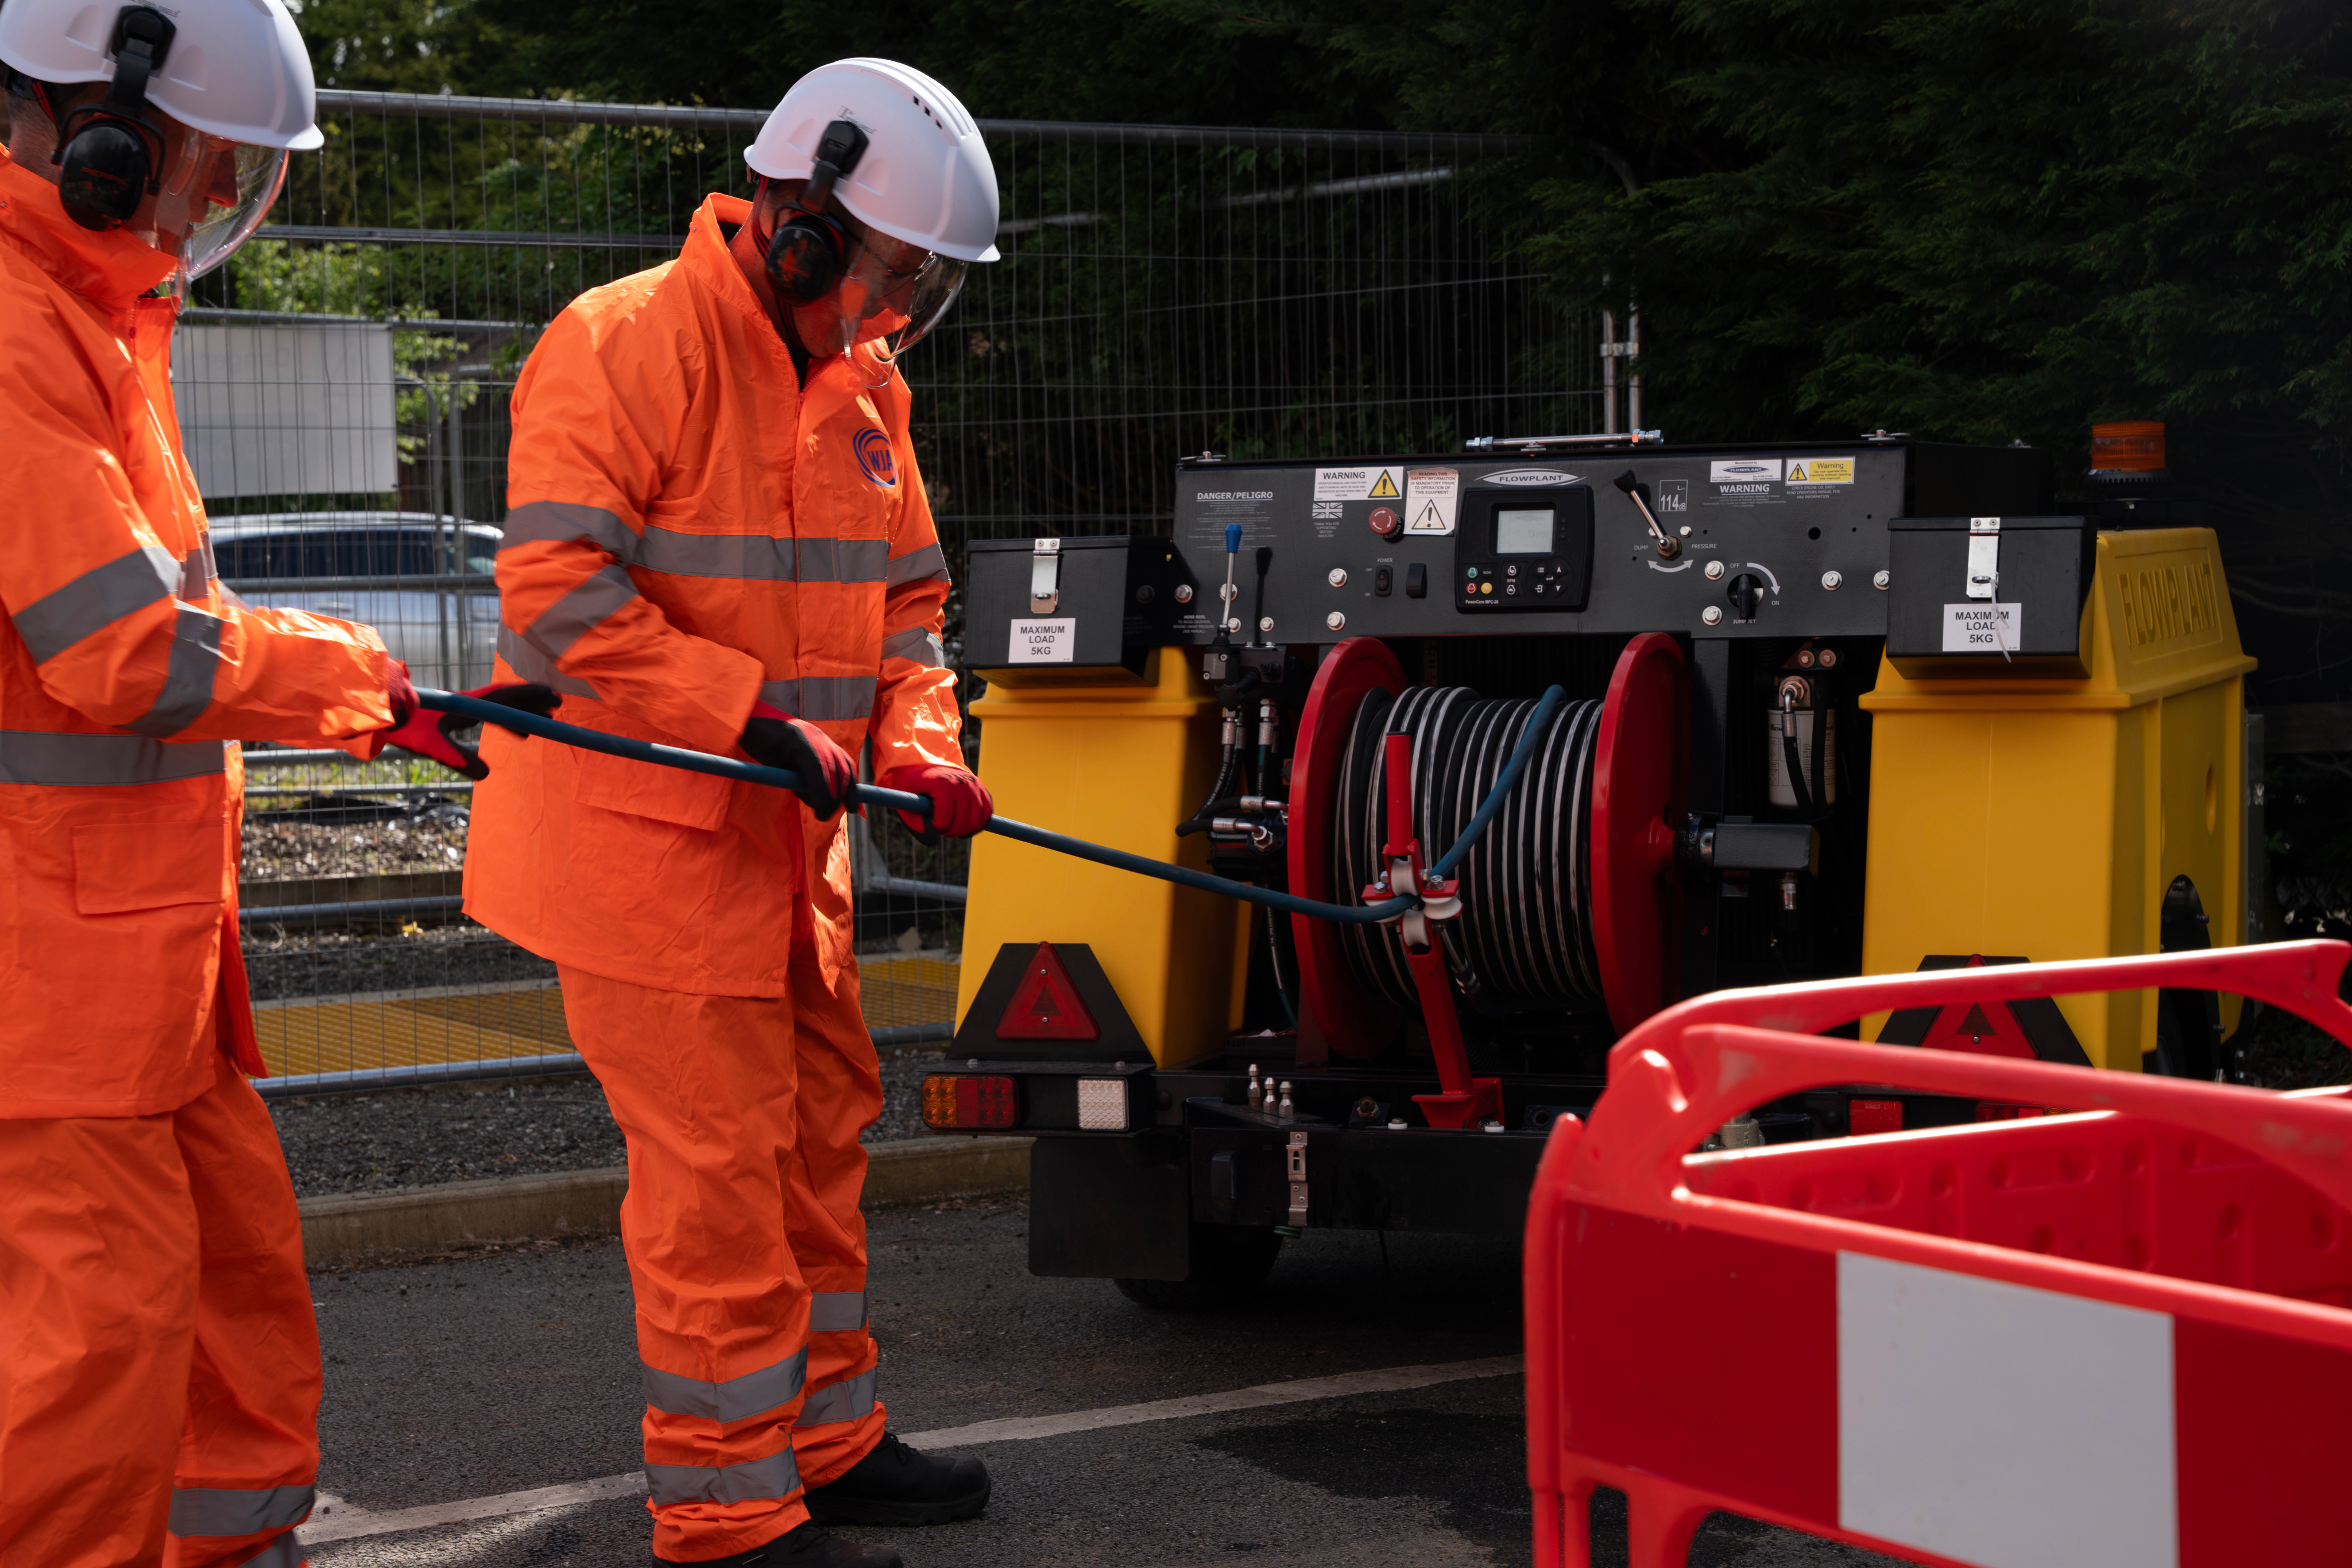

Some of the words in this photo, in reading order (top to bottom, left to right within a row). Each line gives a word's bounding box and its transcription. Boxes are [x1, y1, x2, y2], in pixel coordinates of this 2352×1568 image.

[867, 450, 894, 471] WJA
[1720, 484, 1770, 493] WARNING
[1197, 491, 1273, 500] DANGER/PELIGRO
[2117, 563, 2215, 647] FLOWPLANT
[1955, 611, 2009, 620] MAXIMM
[1020, 626, 1065, 634] MAXIMUM
[1970, 634, 1993, 643] 5KG
[1031, 646, 1051, 655] 5KG
[1206, 793, 1216, 805] WASH
[1214, 780, 1223, 793] HOSE
